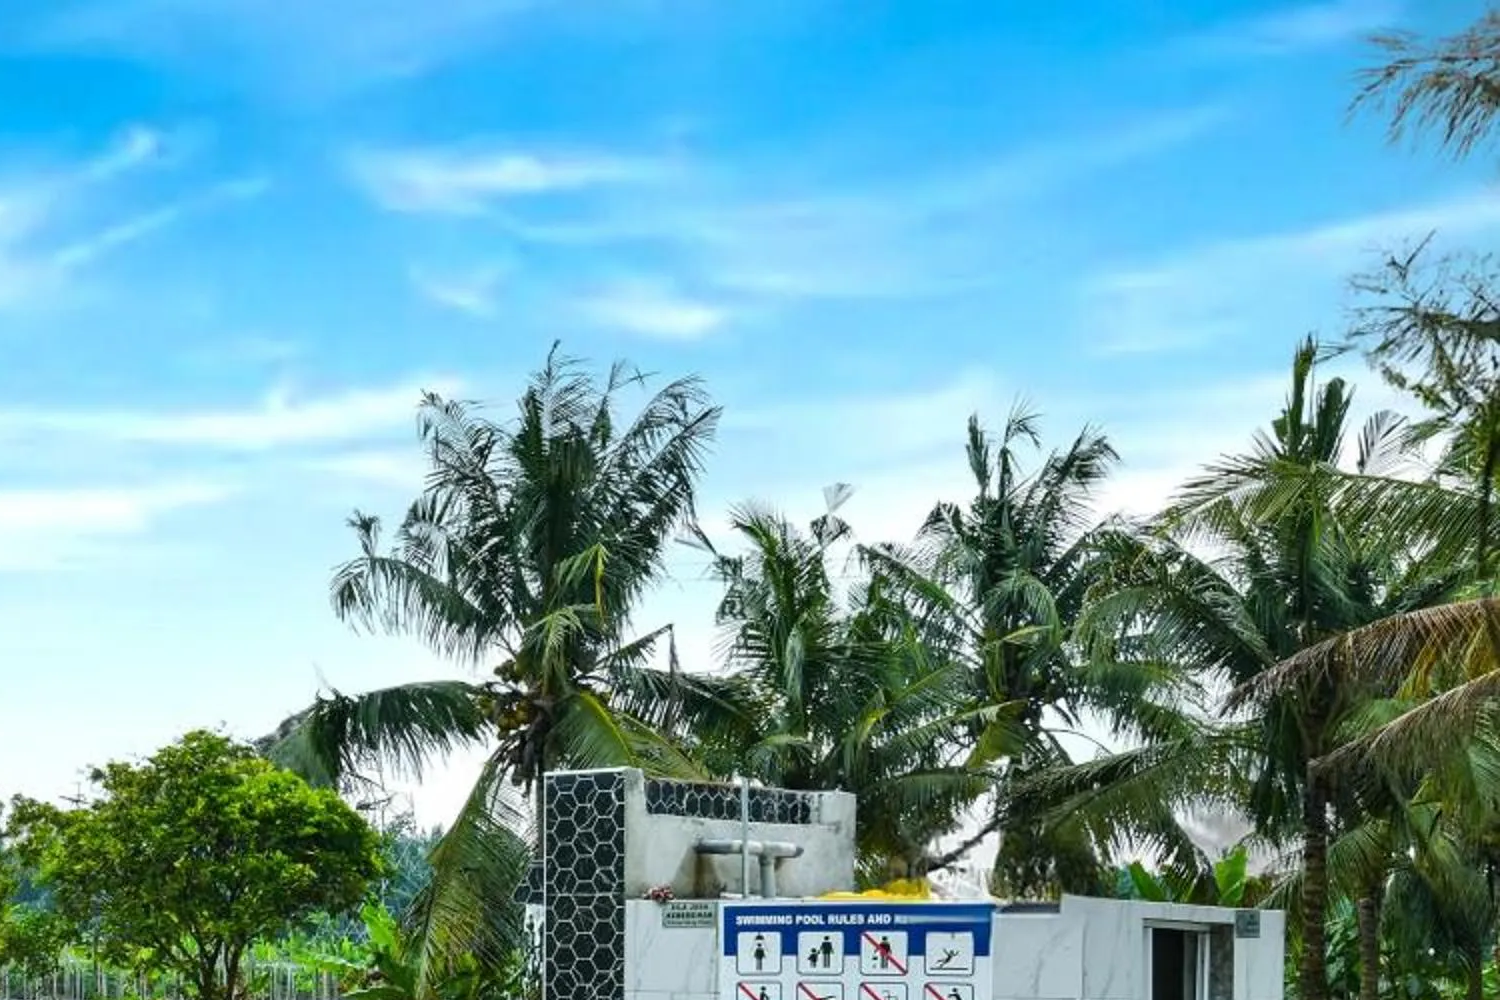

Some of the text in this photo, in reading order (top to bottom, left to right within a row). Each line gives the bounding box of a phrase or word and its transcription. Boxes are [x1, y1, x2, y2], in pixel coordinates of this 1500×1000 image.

[795, 914, 826, 925] POOL
[827, 914, 866, 925] RULES
[867, 914, 892, 925] AND
